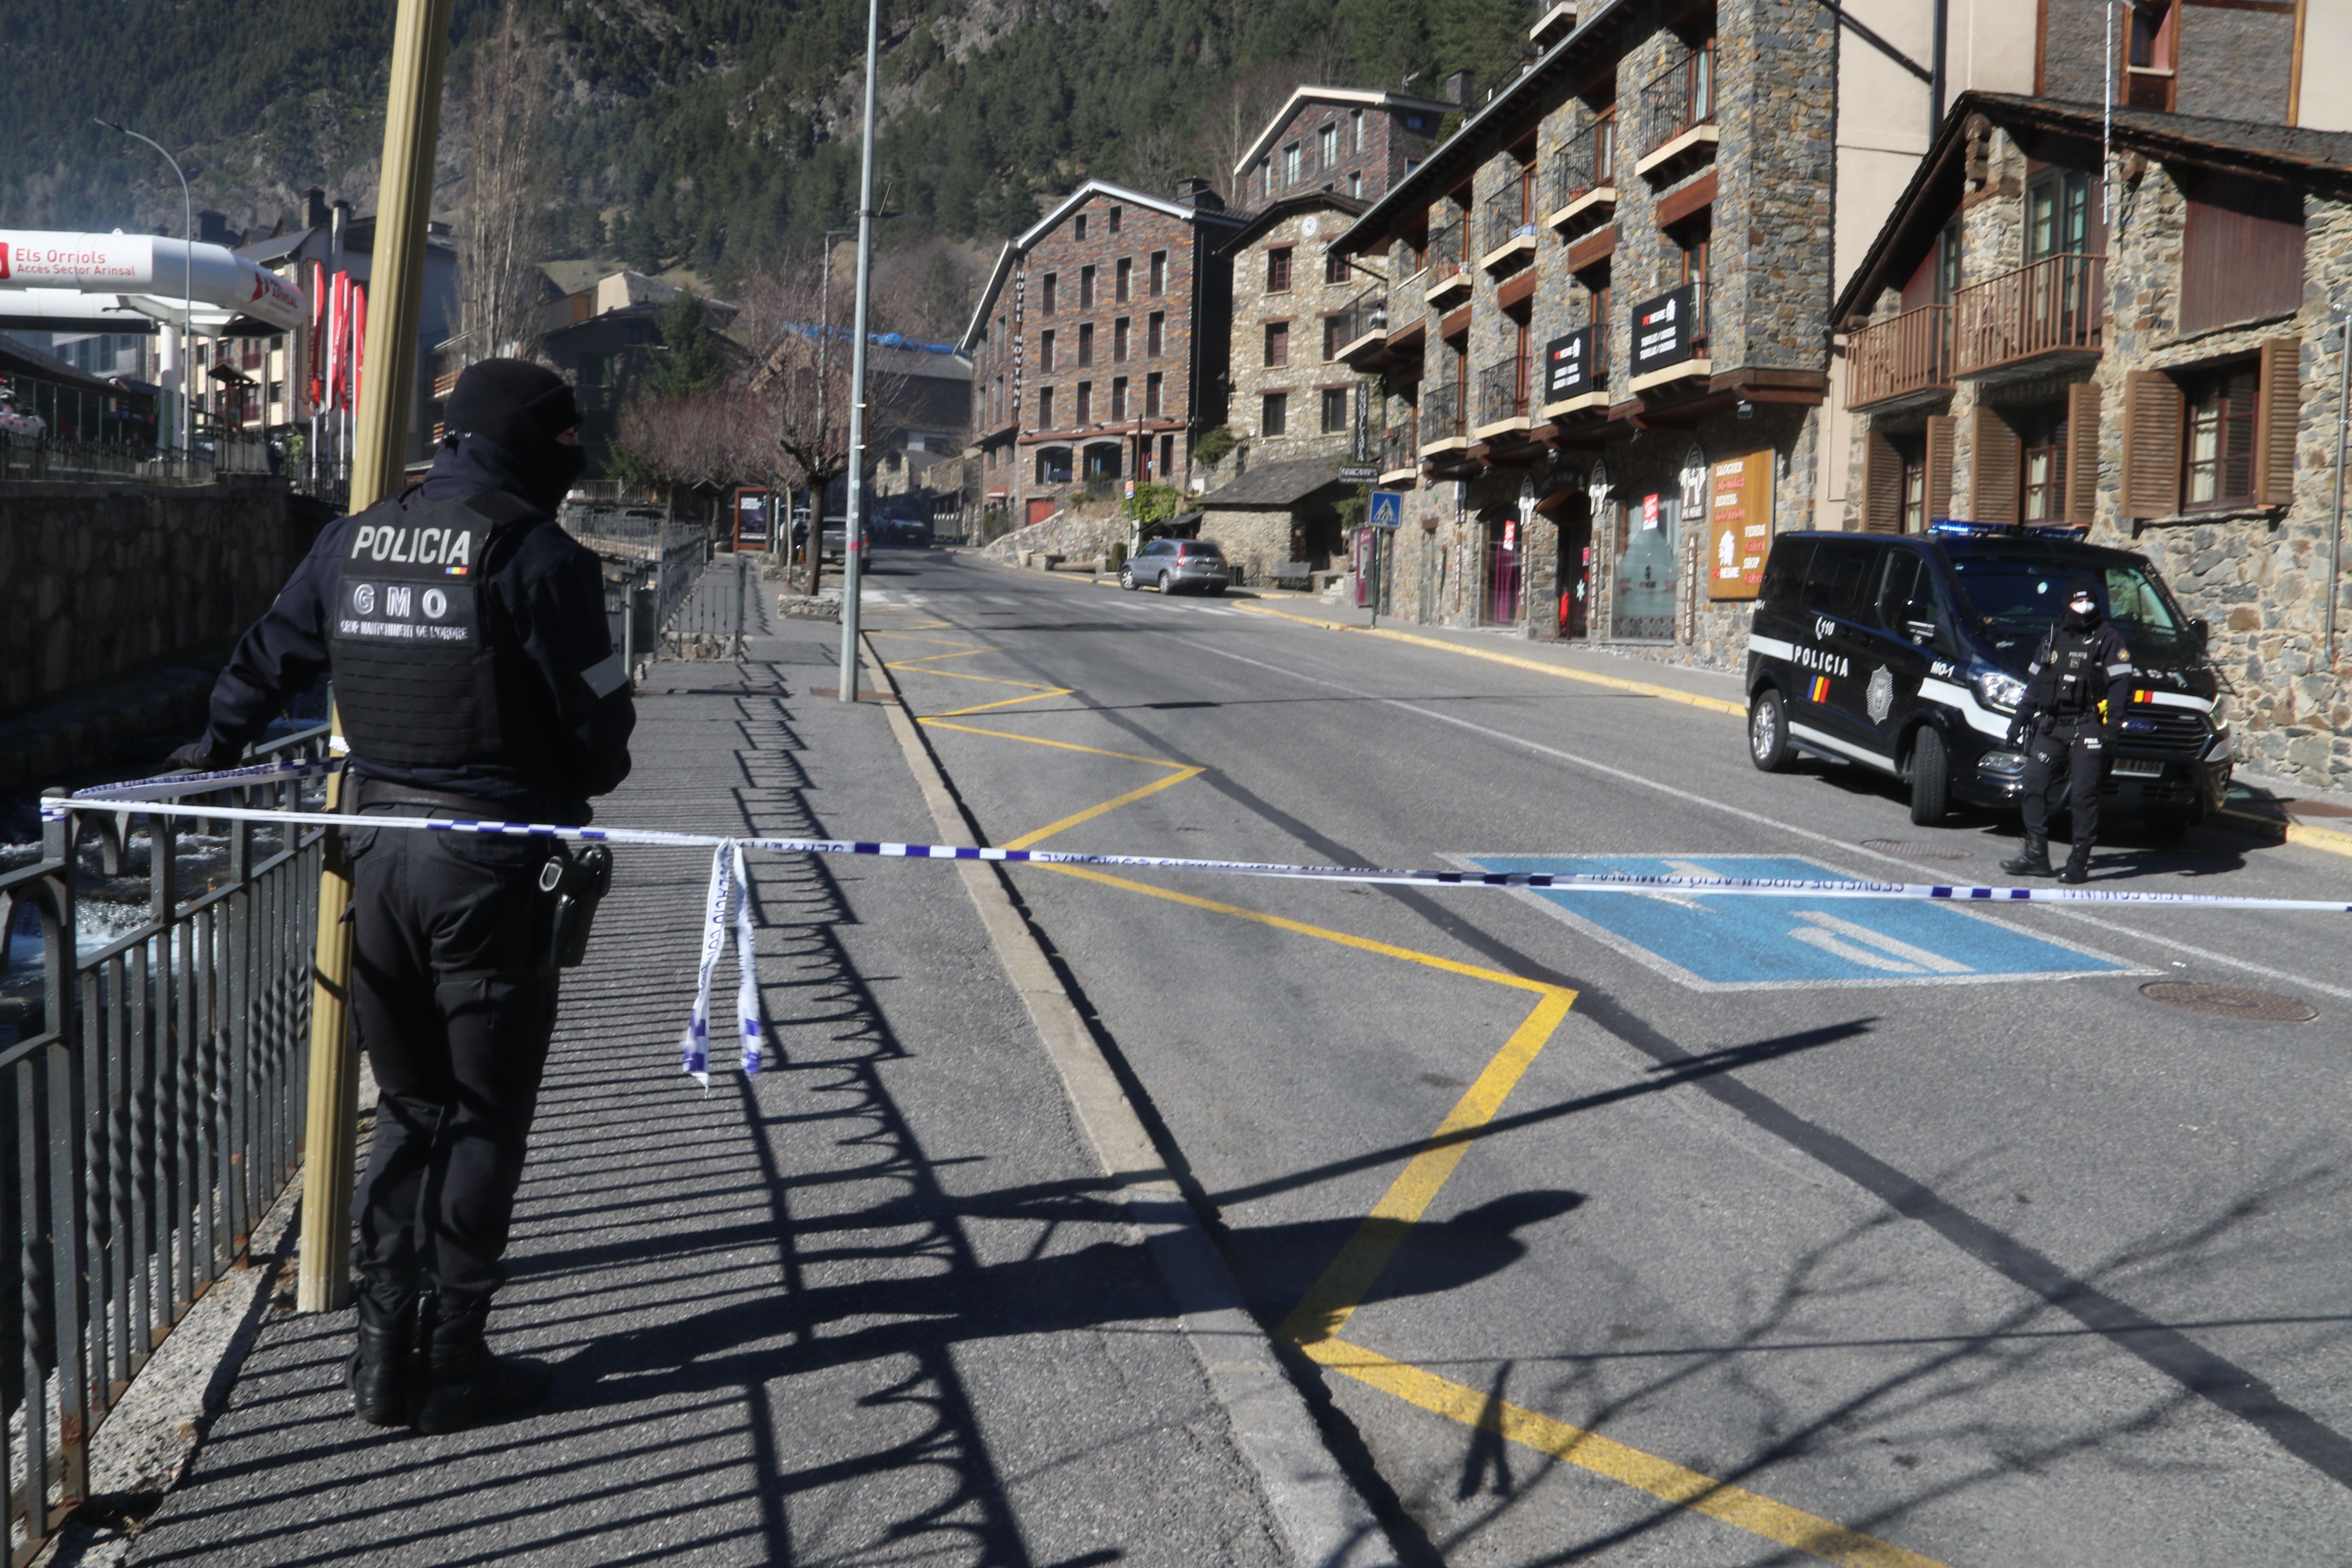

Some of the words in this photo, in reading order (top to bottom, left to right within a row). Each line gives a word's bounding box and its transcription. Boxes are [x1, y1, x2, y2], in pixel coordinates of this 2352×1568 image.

[15, 248, 41, 262] Els
[47, 249, 106, 264] Orriols
[17, 263, 50, 274] Accés
[53, 264, 90, 275] Sector
[94, 266, 136, 276] Arinsal
[1715, 461, 1743, 478] LLOGUER
[351, 525, 471, 565] POLICIA
[1684, 536, 1694, 640] ALQUILER
[360, 621, 414, 638] MANTENIMENT
[416, 625, 428, 638] DE
[429, 625, 469, 640] L'ORDRE
[1821, 620, 1835, 636] 110
[1794, 645, 1848, 677] POLICIA
[1930, 661, 1955, 678] MO-1
